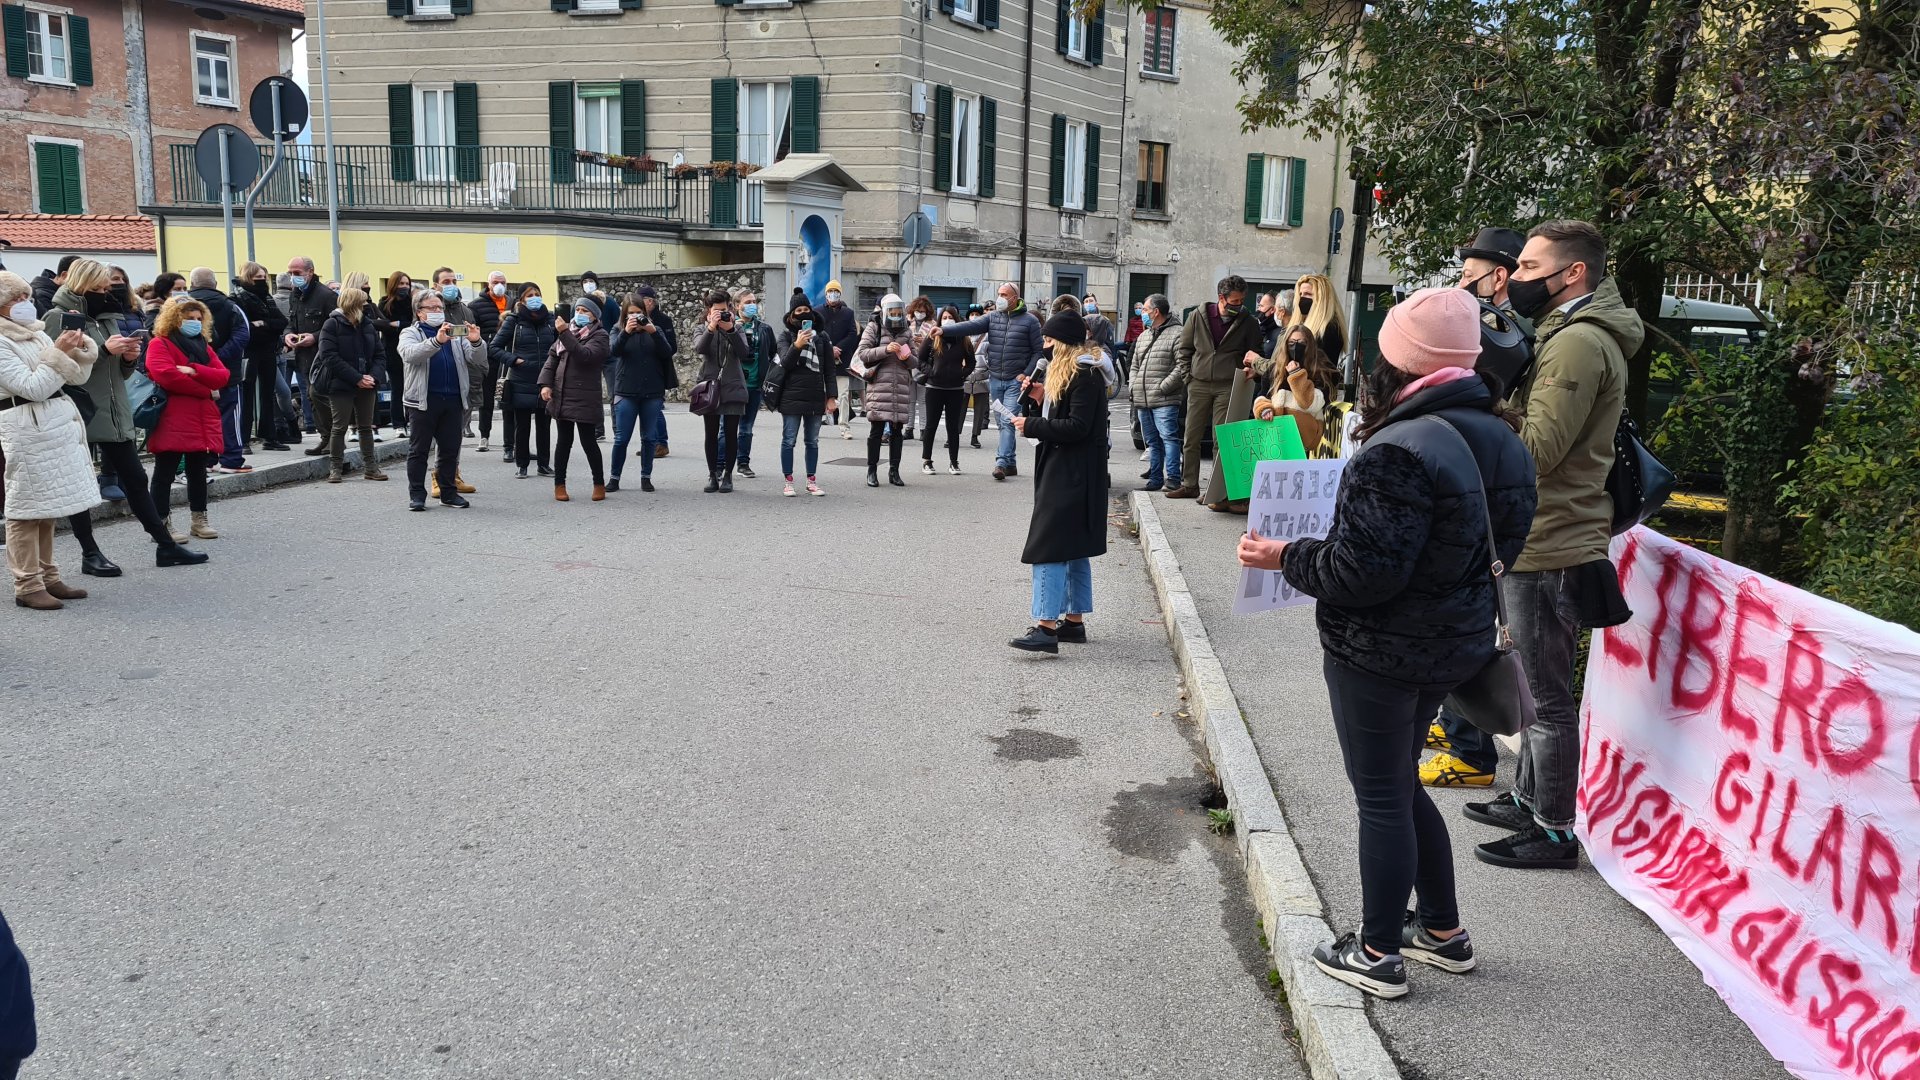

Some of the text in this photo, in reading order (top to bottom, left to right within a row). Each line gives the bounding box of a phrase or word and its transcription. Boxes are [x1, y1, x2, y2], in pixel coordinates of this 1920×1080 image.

[1231, 425, 1286, 448] LIBERATE
[1240, 443, 1282, 462] CARLO
[1603, 532, 1887, 776] LIBERO
[1714, 752, 1920, 972] GILAR
